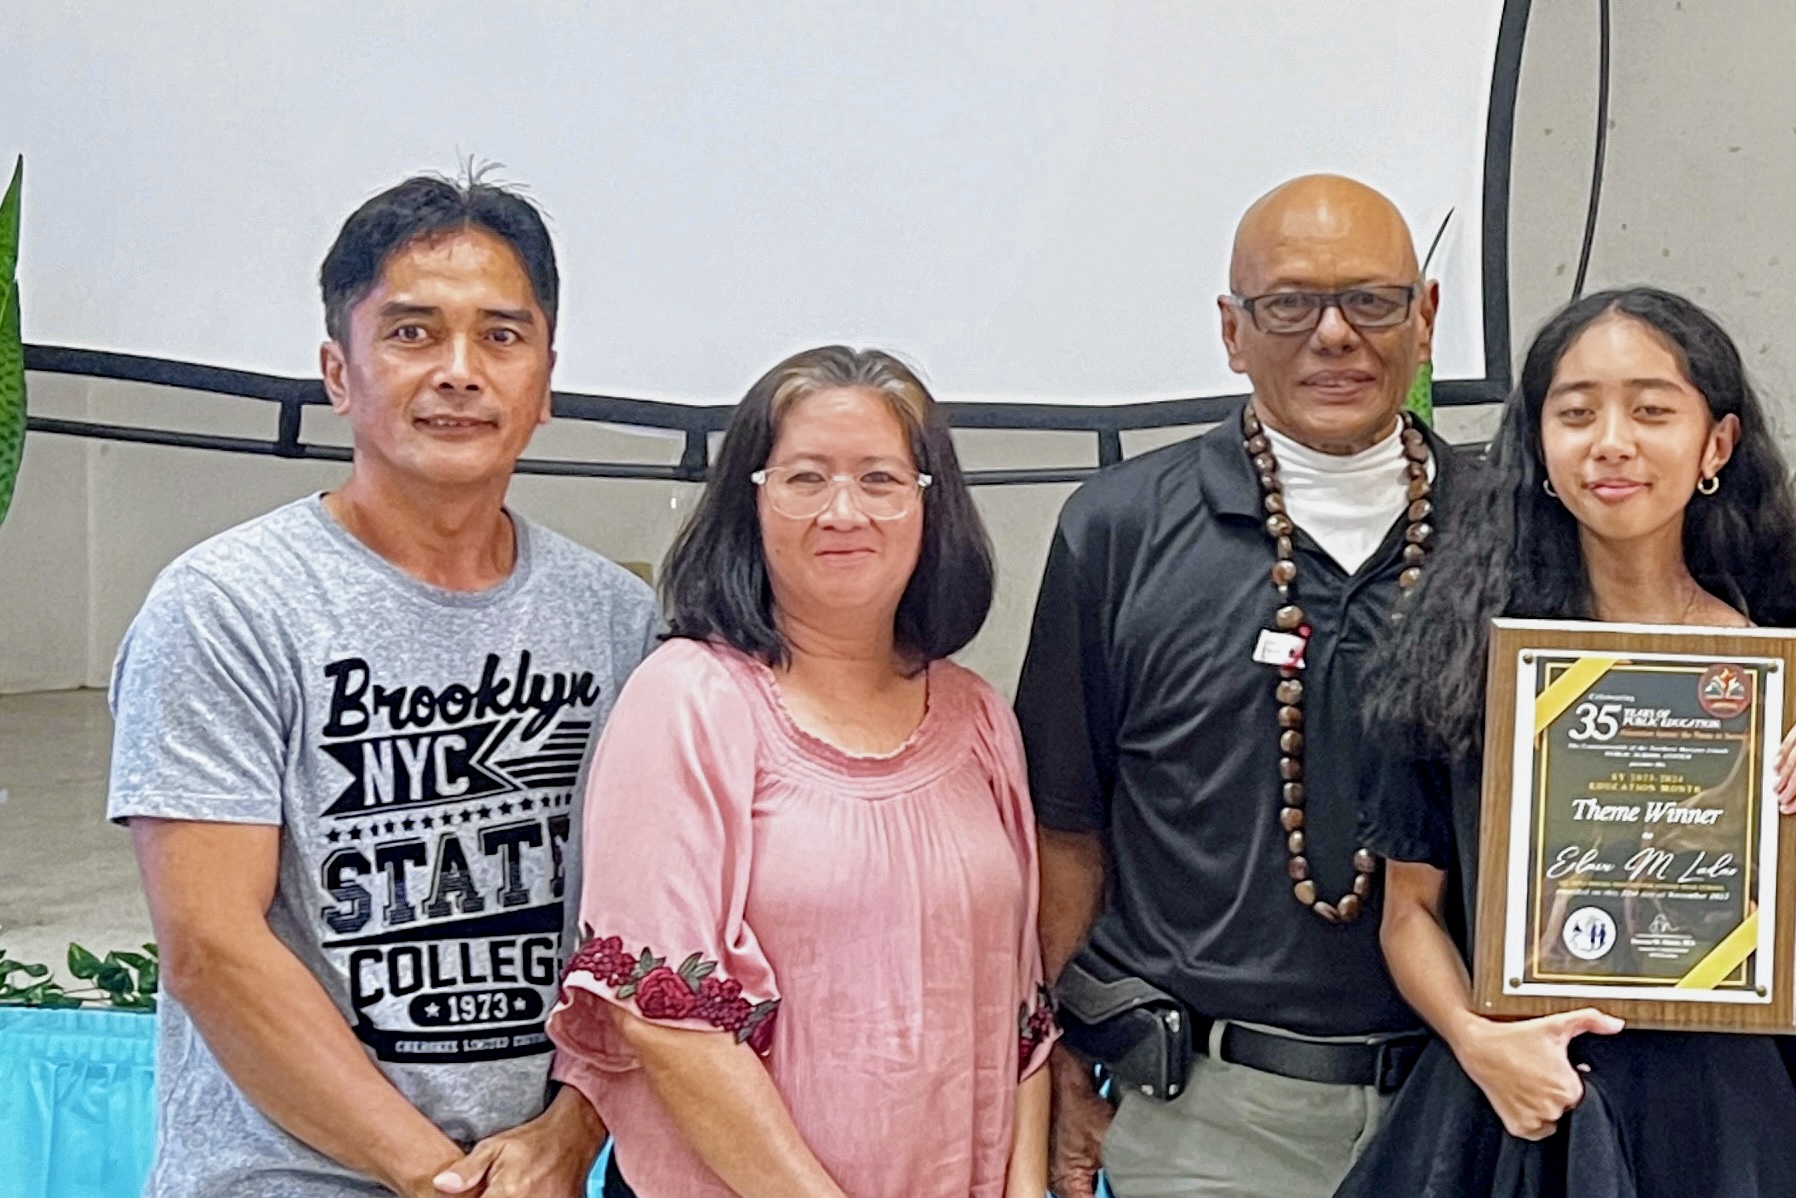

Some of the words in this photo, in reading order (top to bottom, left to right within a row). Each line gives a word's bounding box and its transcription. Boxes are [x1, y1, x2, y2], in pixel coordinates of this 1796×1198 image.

[323, 650, 600, 741] Brooklyn
[1568, 702, 1622, 741] 35
[361, 734, 471, 807] NYC
[1571, 798, 1641, 822] Theme
[1644, 801, 1724, 825] Winner
[1624, 847, 1675, 881] M
[349, 934, 564, 1009] COLLEG
[447, 993, 509, 1023] 1973
